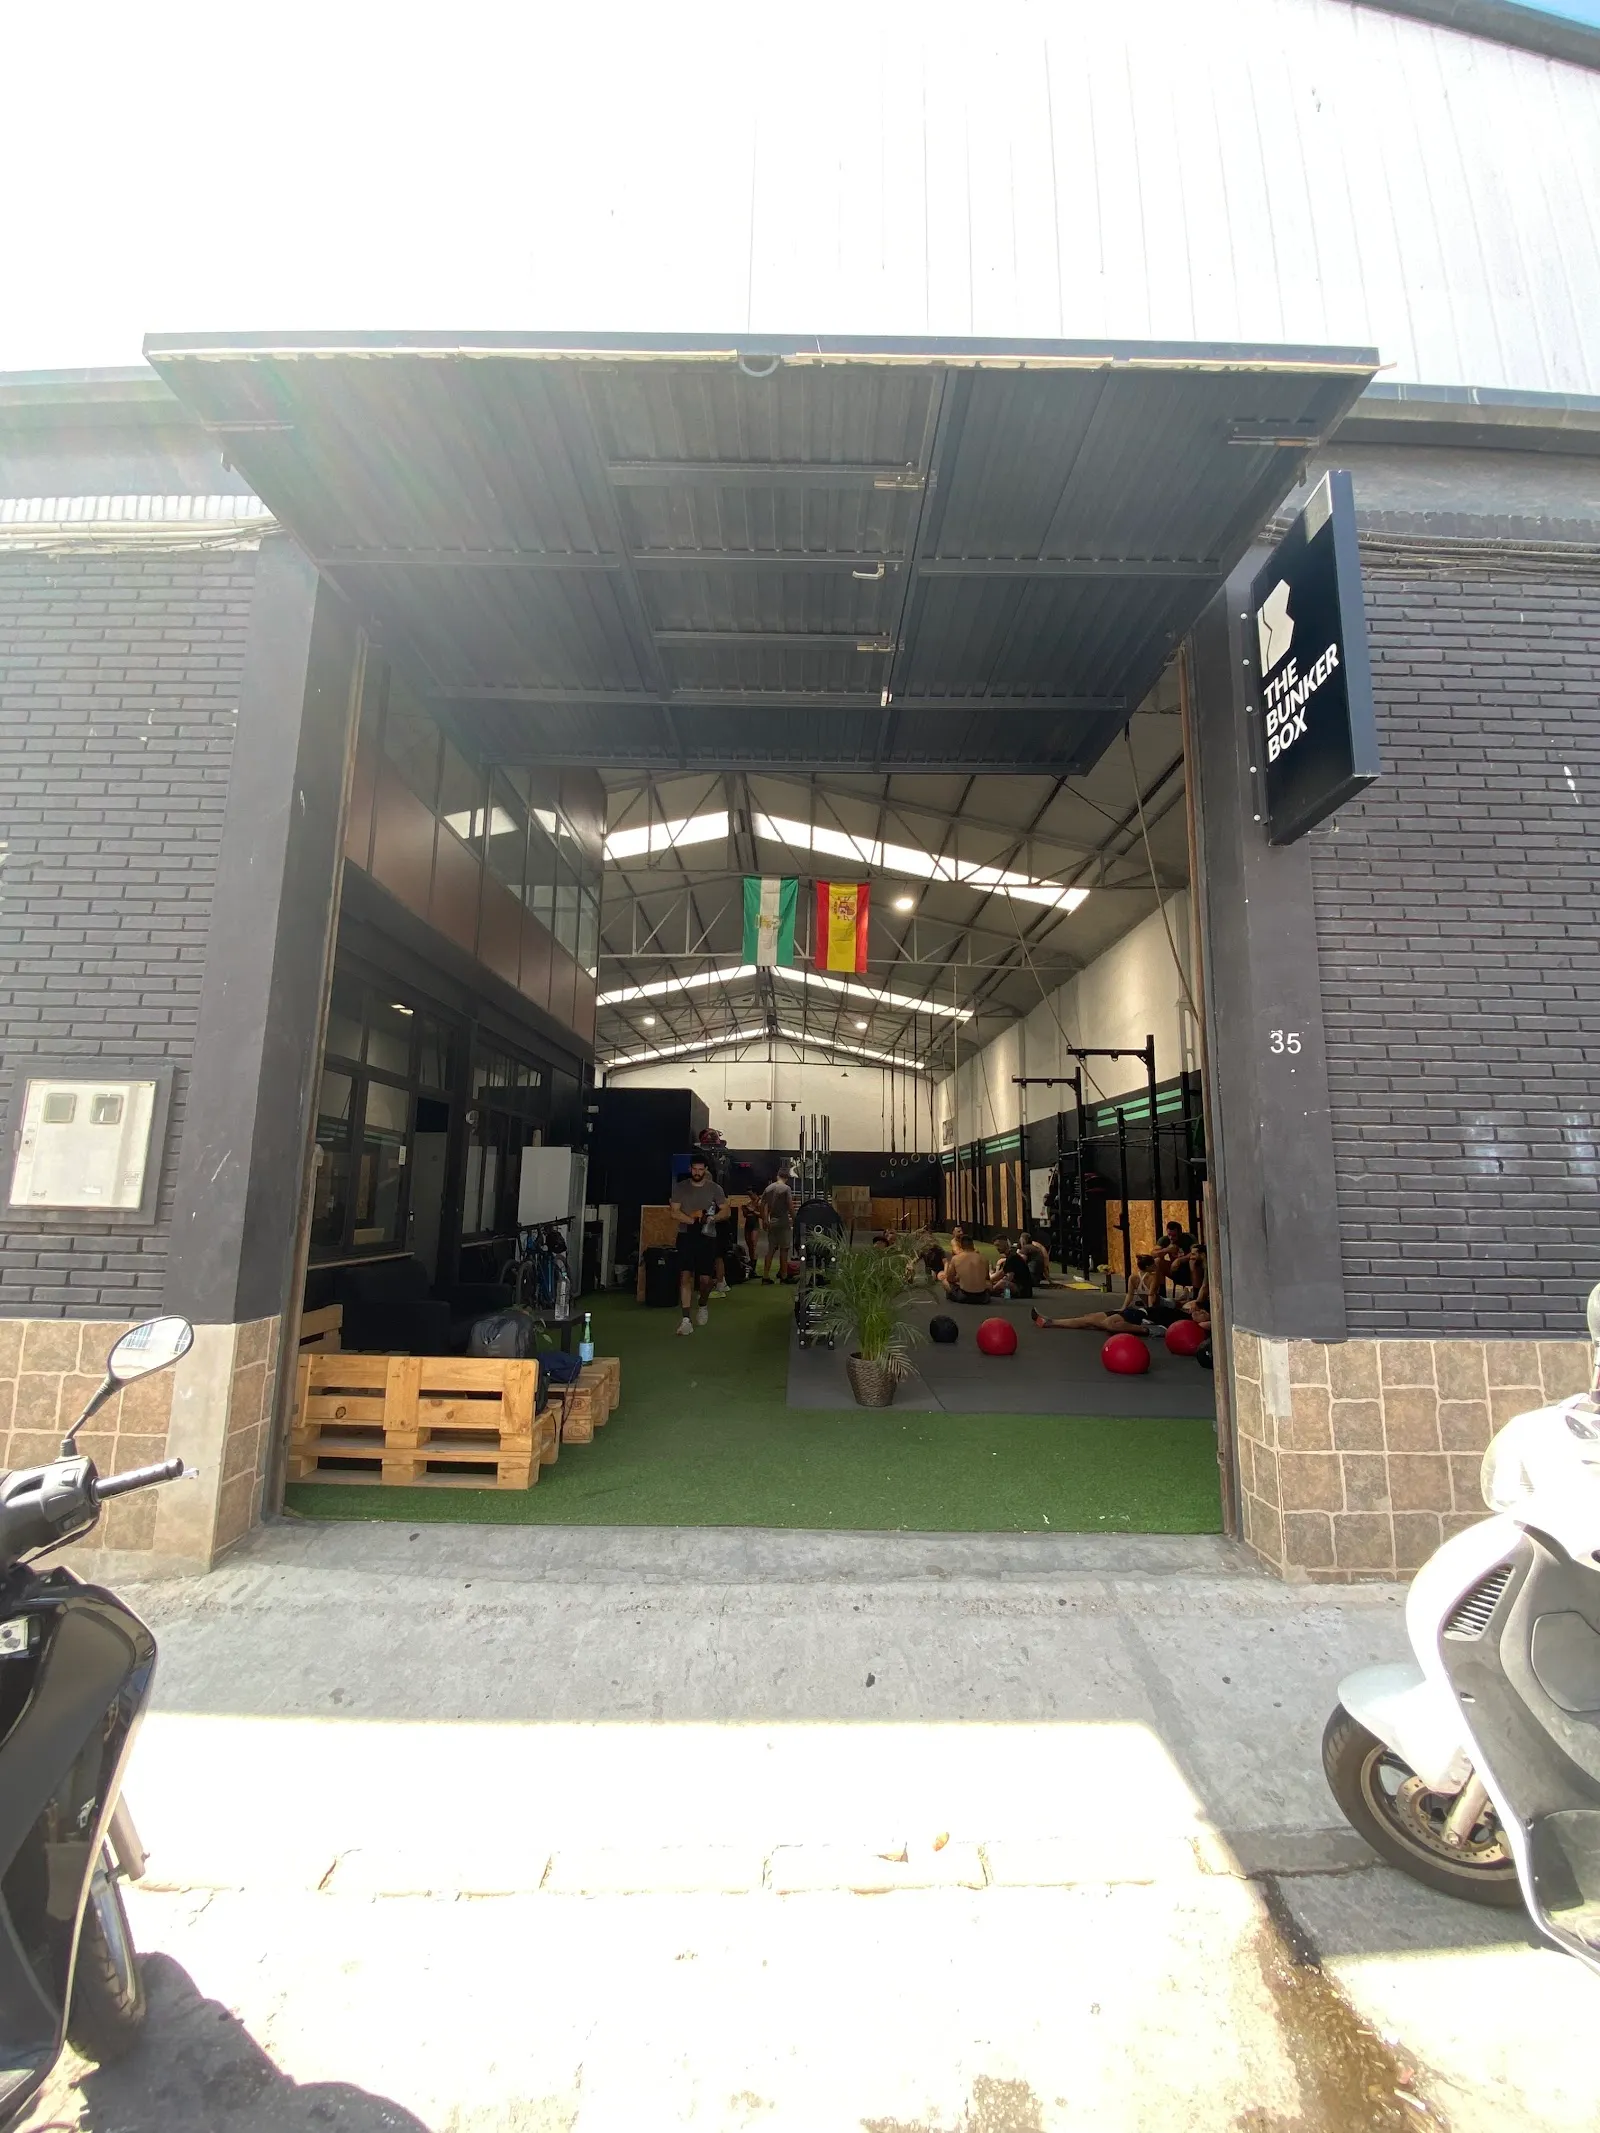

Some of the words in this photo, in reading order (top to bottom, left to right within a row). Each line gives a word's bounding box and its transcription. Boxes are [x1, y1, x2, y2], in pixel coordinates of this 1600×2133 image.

[1264, 657, 1298, 708] THE
[1266, 643, 1339, 737] BUNKER
[1268, 706, 1307, 762] BOX
[1269, 1032, 1302, 1054] 35
